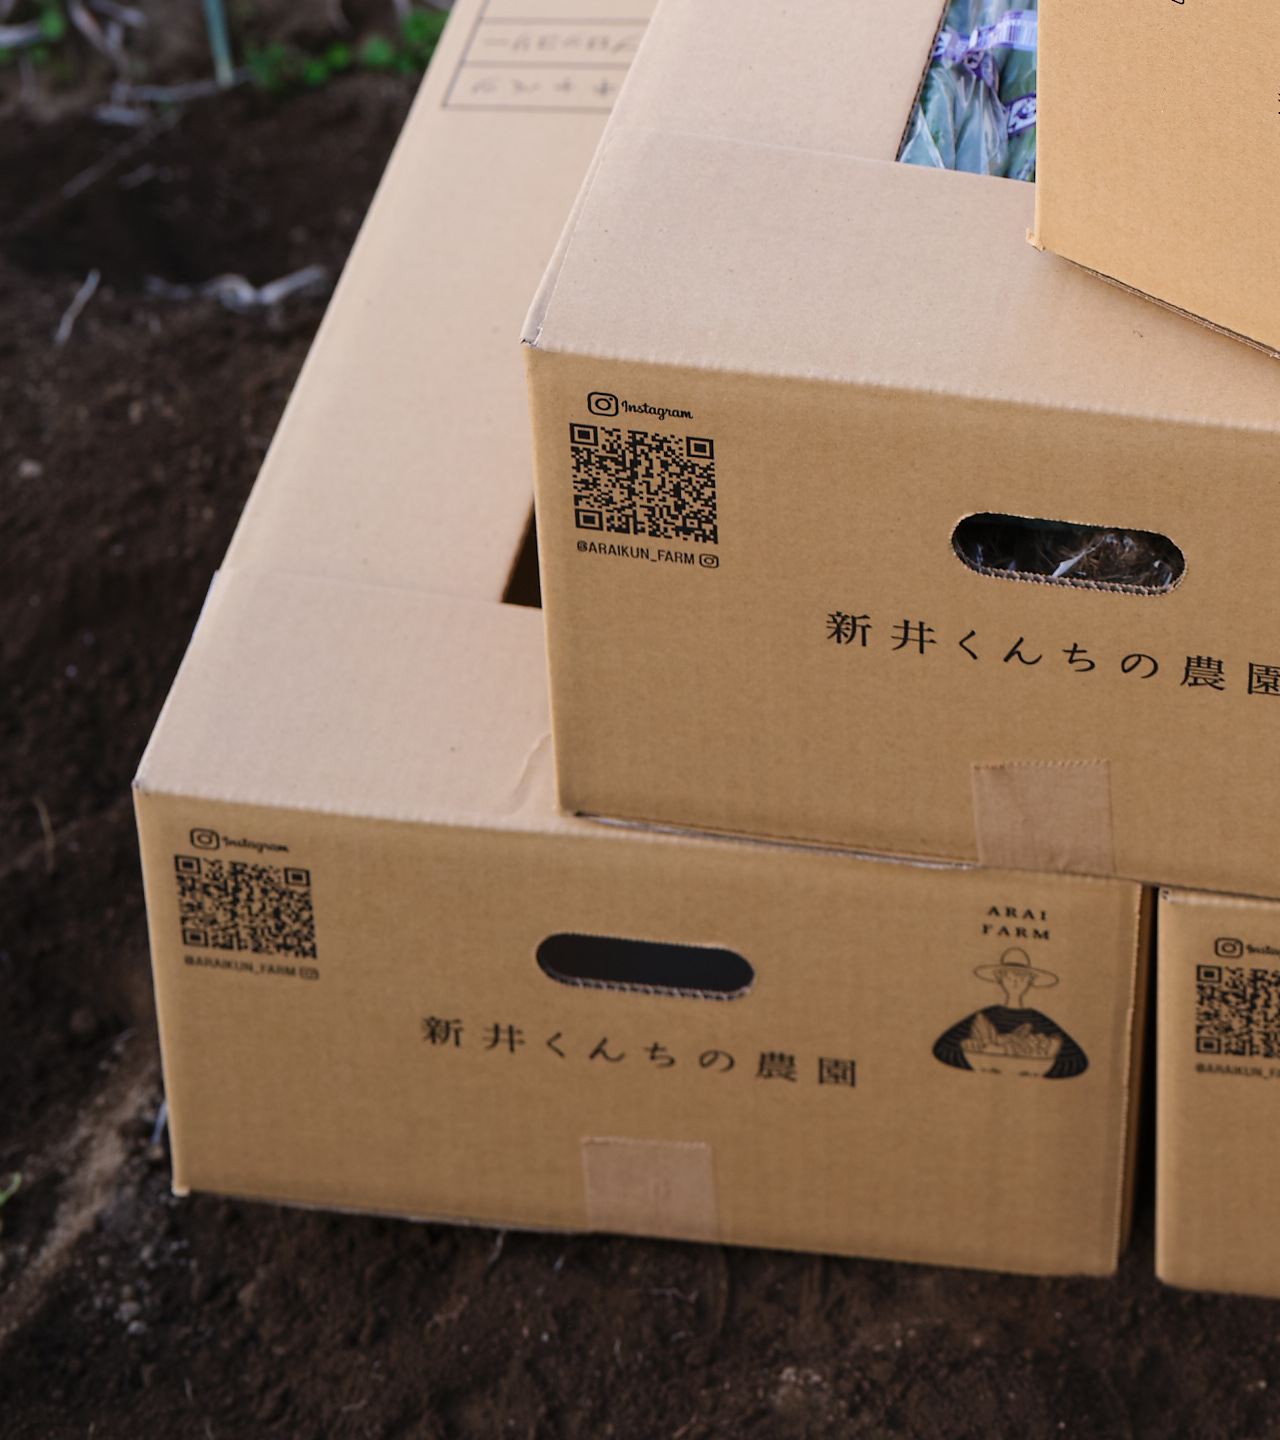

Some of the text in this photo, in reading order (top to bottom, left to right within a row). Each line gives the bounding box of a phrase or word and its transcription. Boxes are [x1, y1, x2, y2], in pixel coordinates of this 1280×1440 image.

[621, 400, 693, 420] Instagram
[577, 540, 695, 565] @ARAIKUN_FARM
[222, 836, 290, 854] Instagram
[987, 905, 1047, 922] ARAI
[982, 923, 1050, 941] FARM
[423, 1015, 857, 1089] 新井くんちの農園
